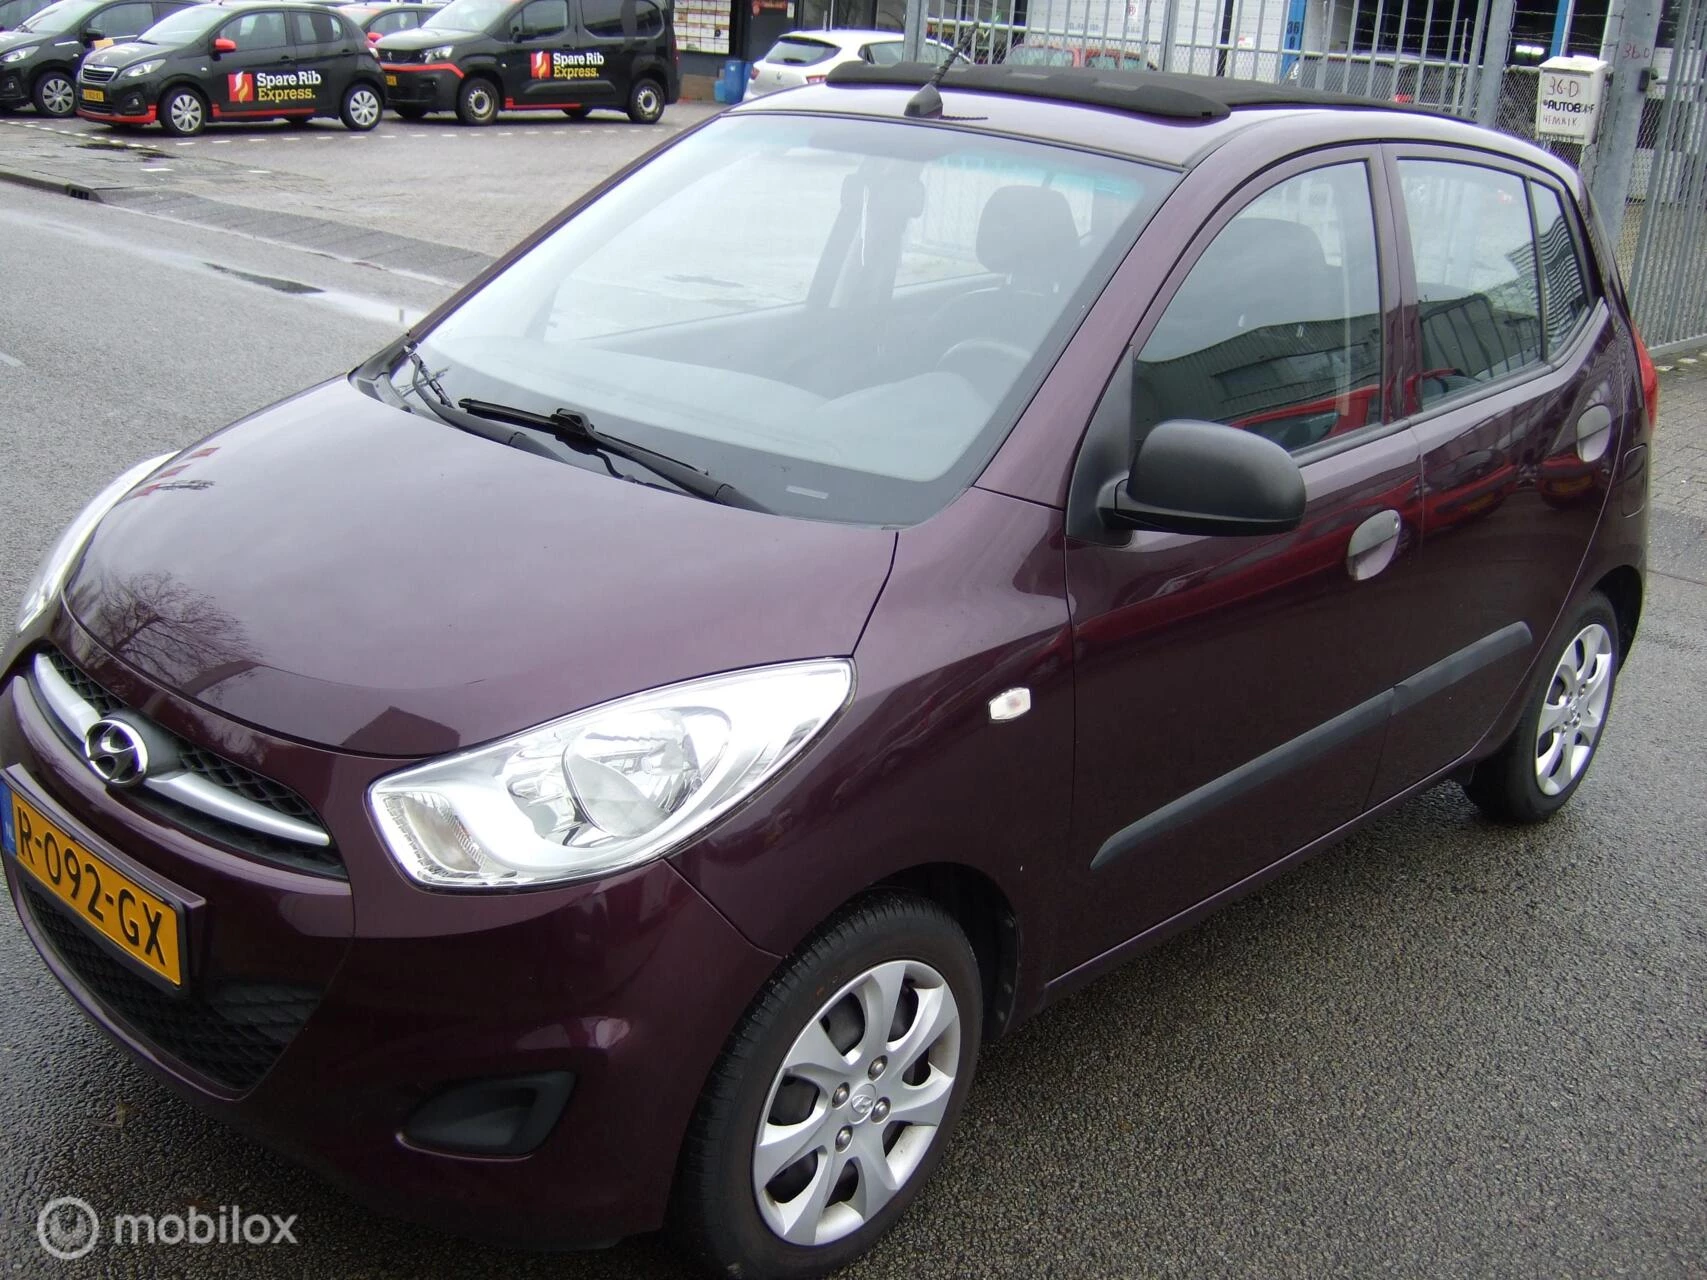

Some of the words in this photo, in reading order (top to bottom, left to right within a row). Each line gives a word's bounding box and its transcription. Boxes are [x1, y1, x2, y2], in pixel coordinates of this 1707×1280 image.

[553, 52, 585, 67] Spare
[586, 52, 605, 65] Rib
[257, 72, 297, 89] Spare
[298, 70, 322, 85] Rib
[554, 66, 600, 80] Express.
[258, 87, 316, 103] Express.
[17, 806, 166, 967] R-092-GX
